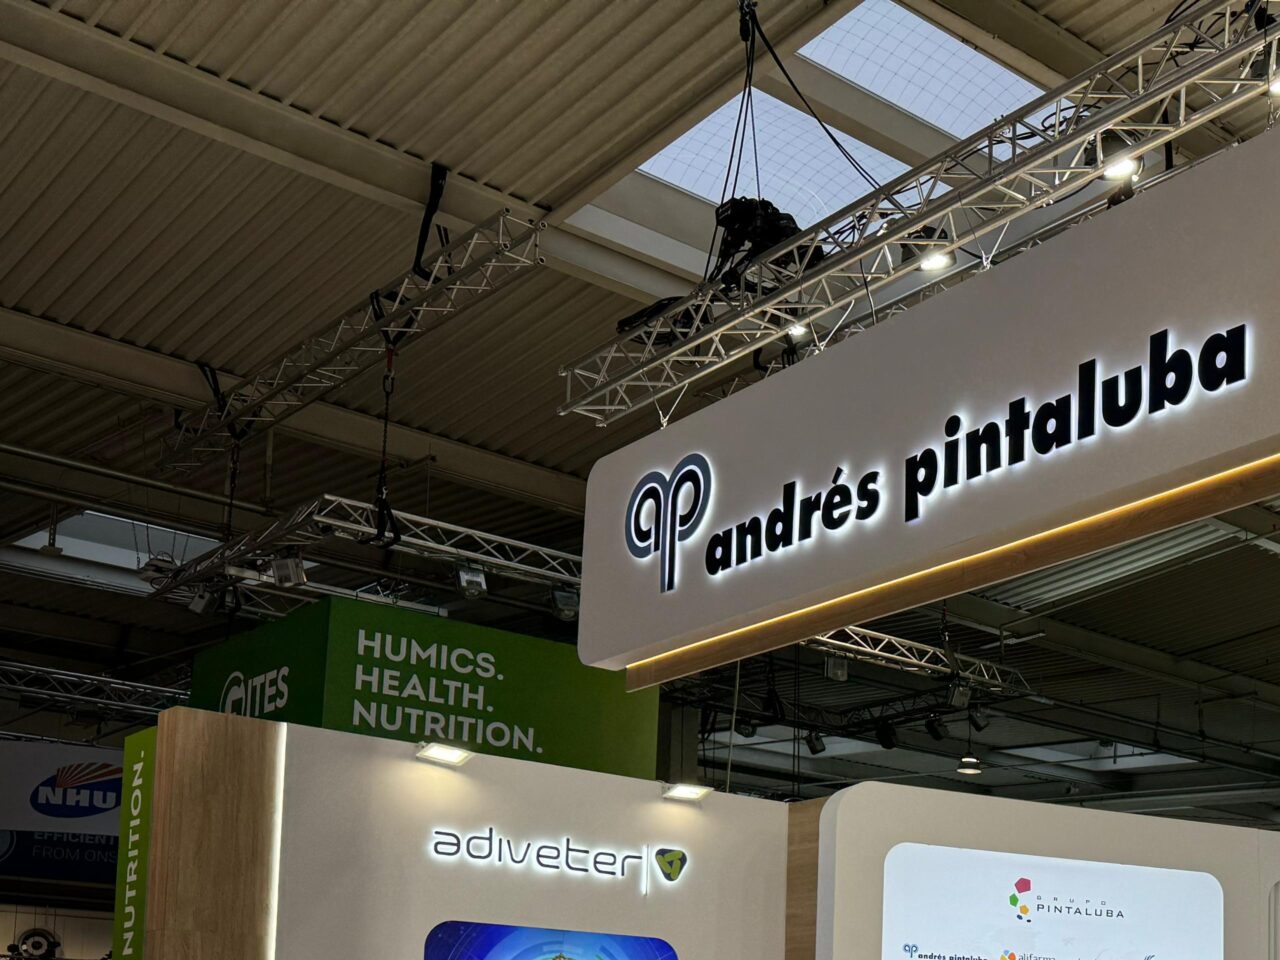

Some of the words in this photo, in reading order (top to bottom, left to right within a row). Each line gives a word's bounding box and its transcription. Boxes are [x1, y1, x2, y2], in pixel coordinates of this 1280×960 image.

[704, 466, 880, 577] andrés
[904, 323, 1247, 522] pintaluba
[357, 628, 504, 681] HUMICS.
[354, 663, 494, 713] HEALTH.
[352, 698, 544, 754] NUTRITION.
[37, 785, 117, 809] NHU
[32, 845, 80, 861] FROM
[122, 750, 145, 955] NUTRITION.
[433, 826, 643, 877] adiveter
[1036, 903, 1124, 919] PINTALUBA
[918, 952, 946, 960] andrés
